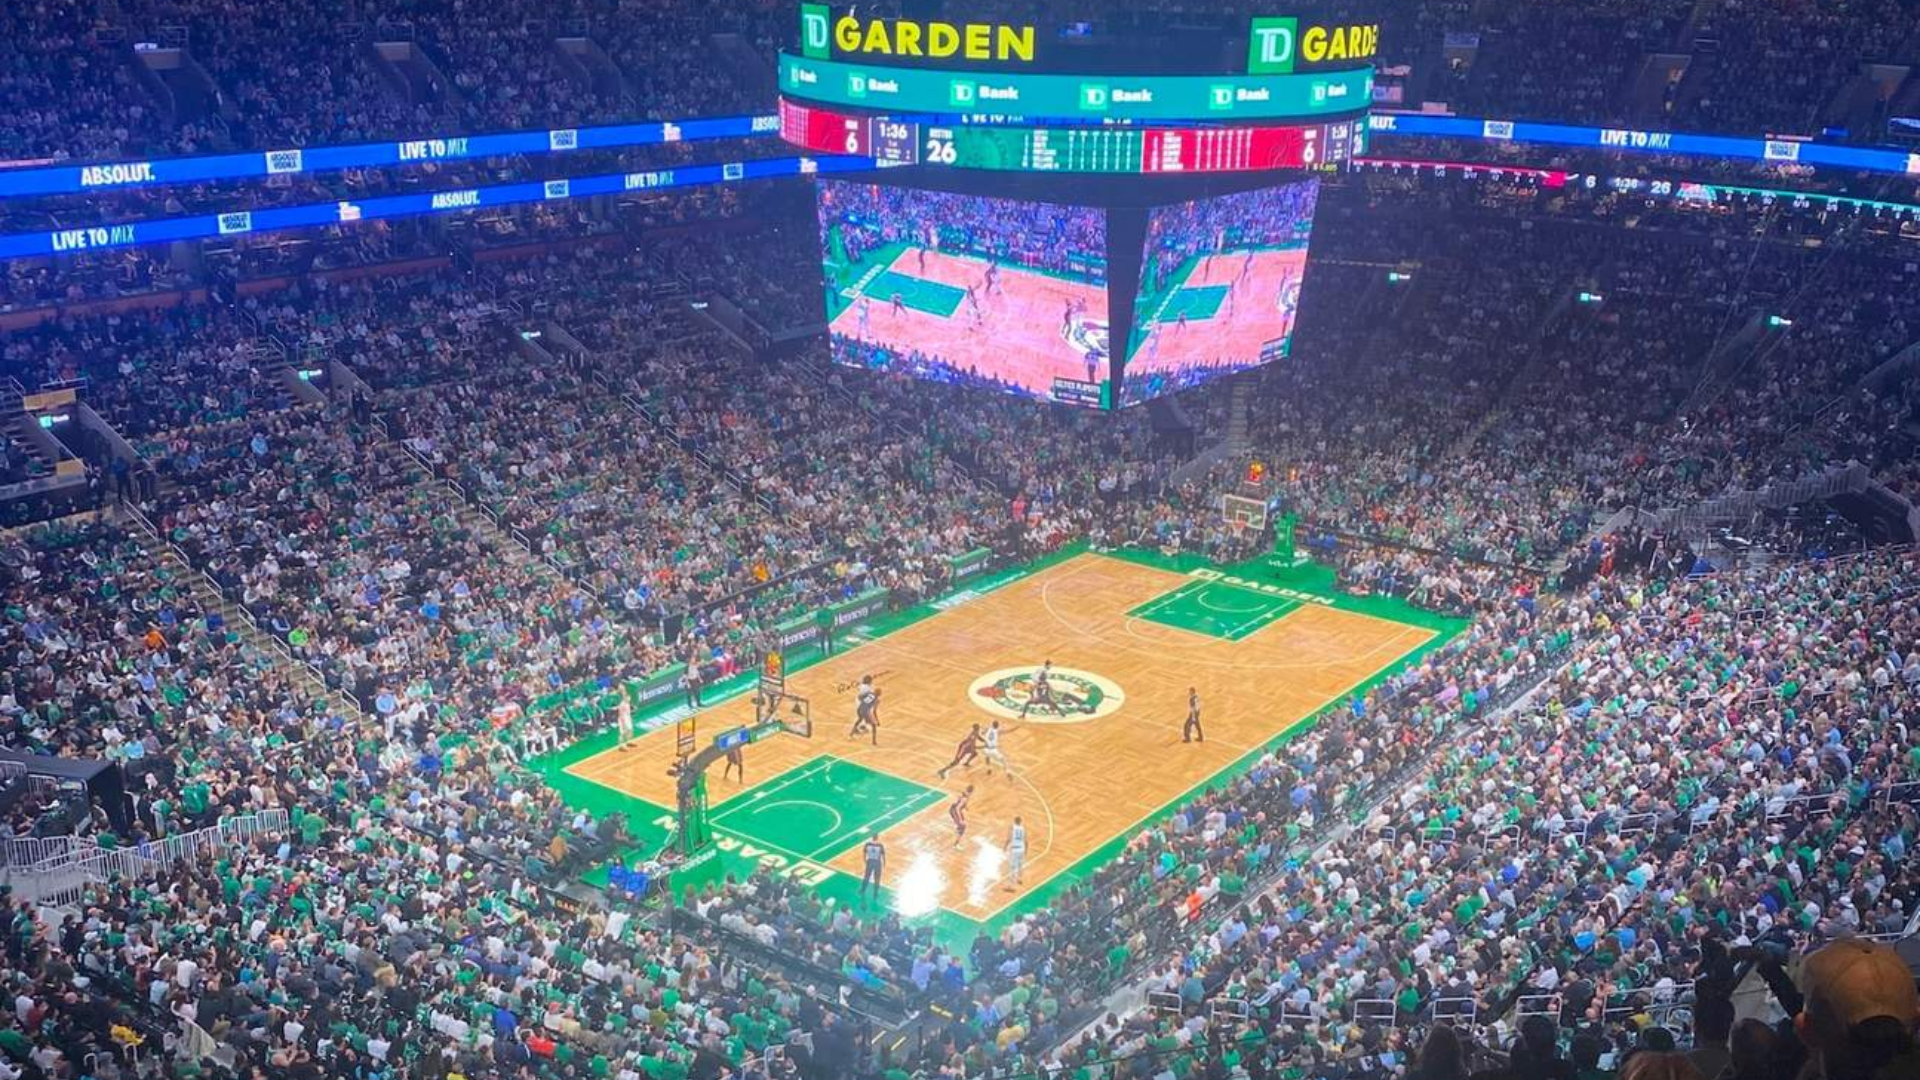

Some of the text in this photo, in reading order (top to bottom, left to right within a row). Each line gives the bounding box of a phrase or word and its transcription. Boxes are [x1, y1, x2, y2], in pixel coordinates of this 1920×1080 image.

[804, 14, 1035, 61] TD GARDEN
[1255, 27, 1292, 63] TD
[868, 77, 899, 93] Bank
[954, 84, 1019, 101] TD Bank
[1085, 88, 1152, 105] TD Bank
[1212, 87, 1270, 105] TD Bank
[879, 122, 908, 139] 1:36
[1600, 128, 1672, 149] LIVE TO MIX
[399, 137, 468, 160] LIVE TO MIX
[845, 132, 859, 154] 6
[926, 139, 958, 164] 26
[1303, 140, 1316, 163] 6
[81, 163, 155, 186] ABSOLUT.
[625, 174, 645, 189] LIVE
[645, 172, 658, 187] TO
[1650, 180, 1672, 195] 26
[52, 226, 135, 250] LIVE TO MIX
